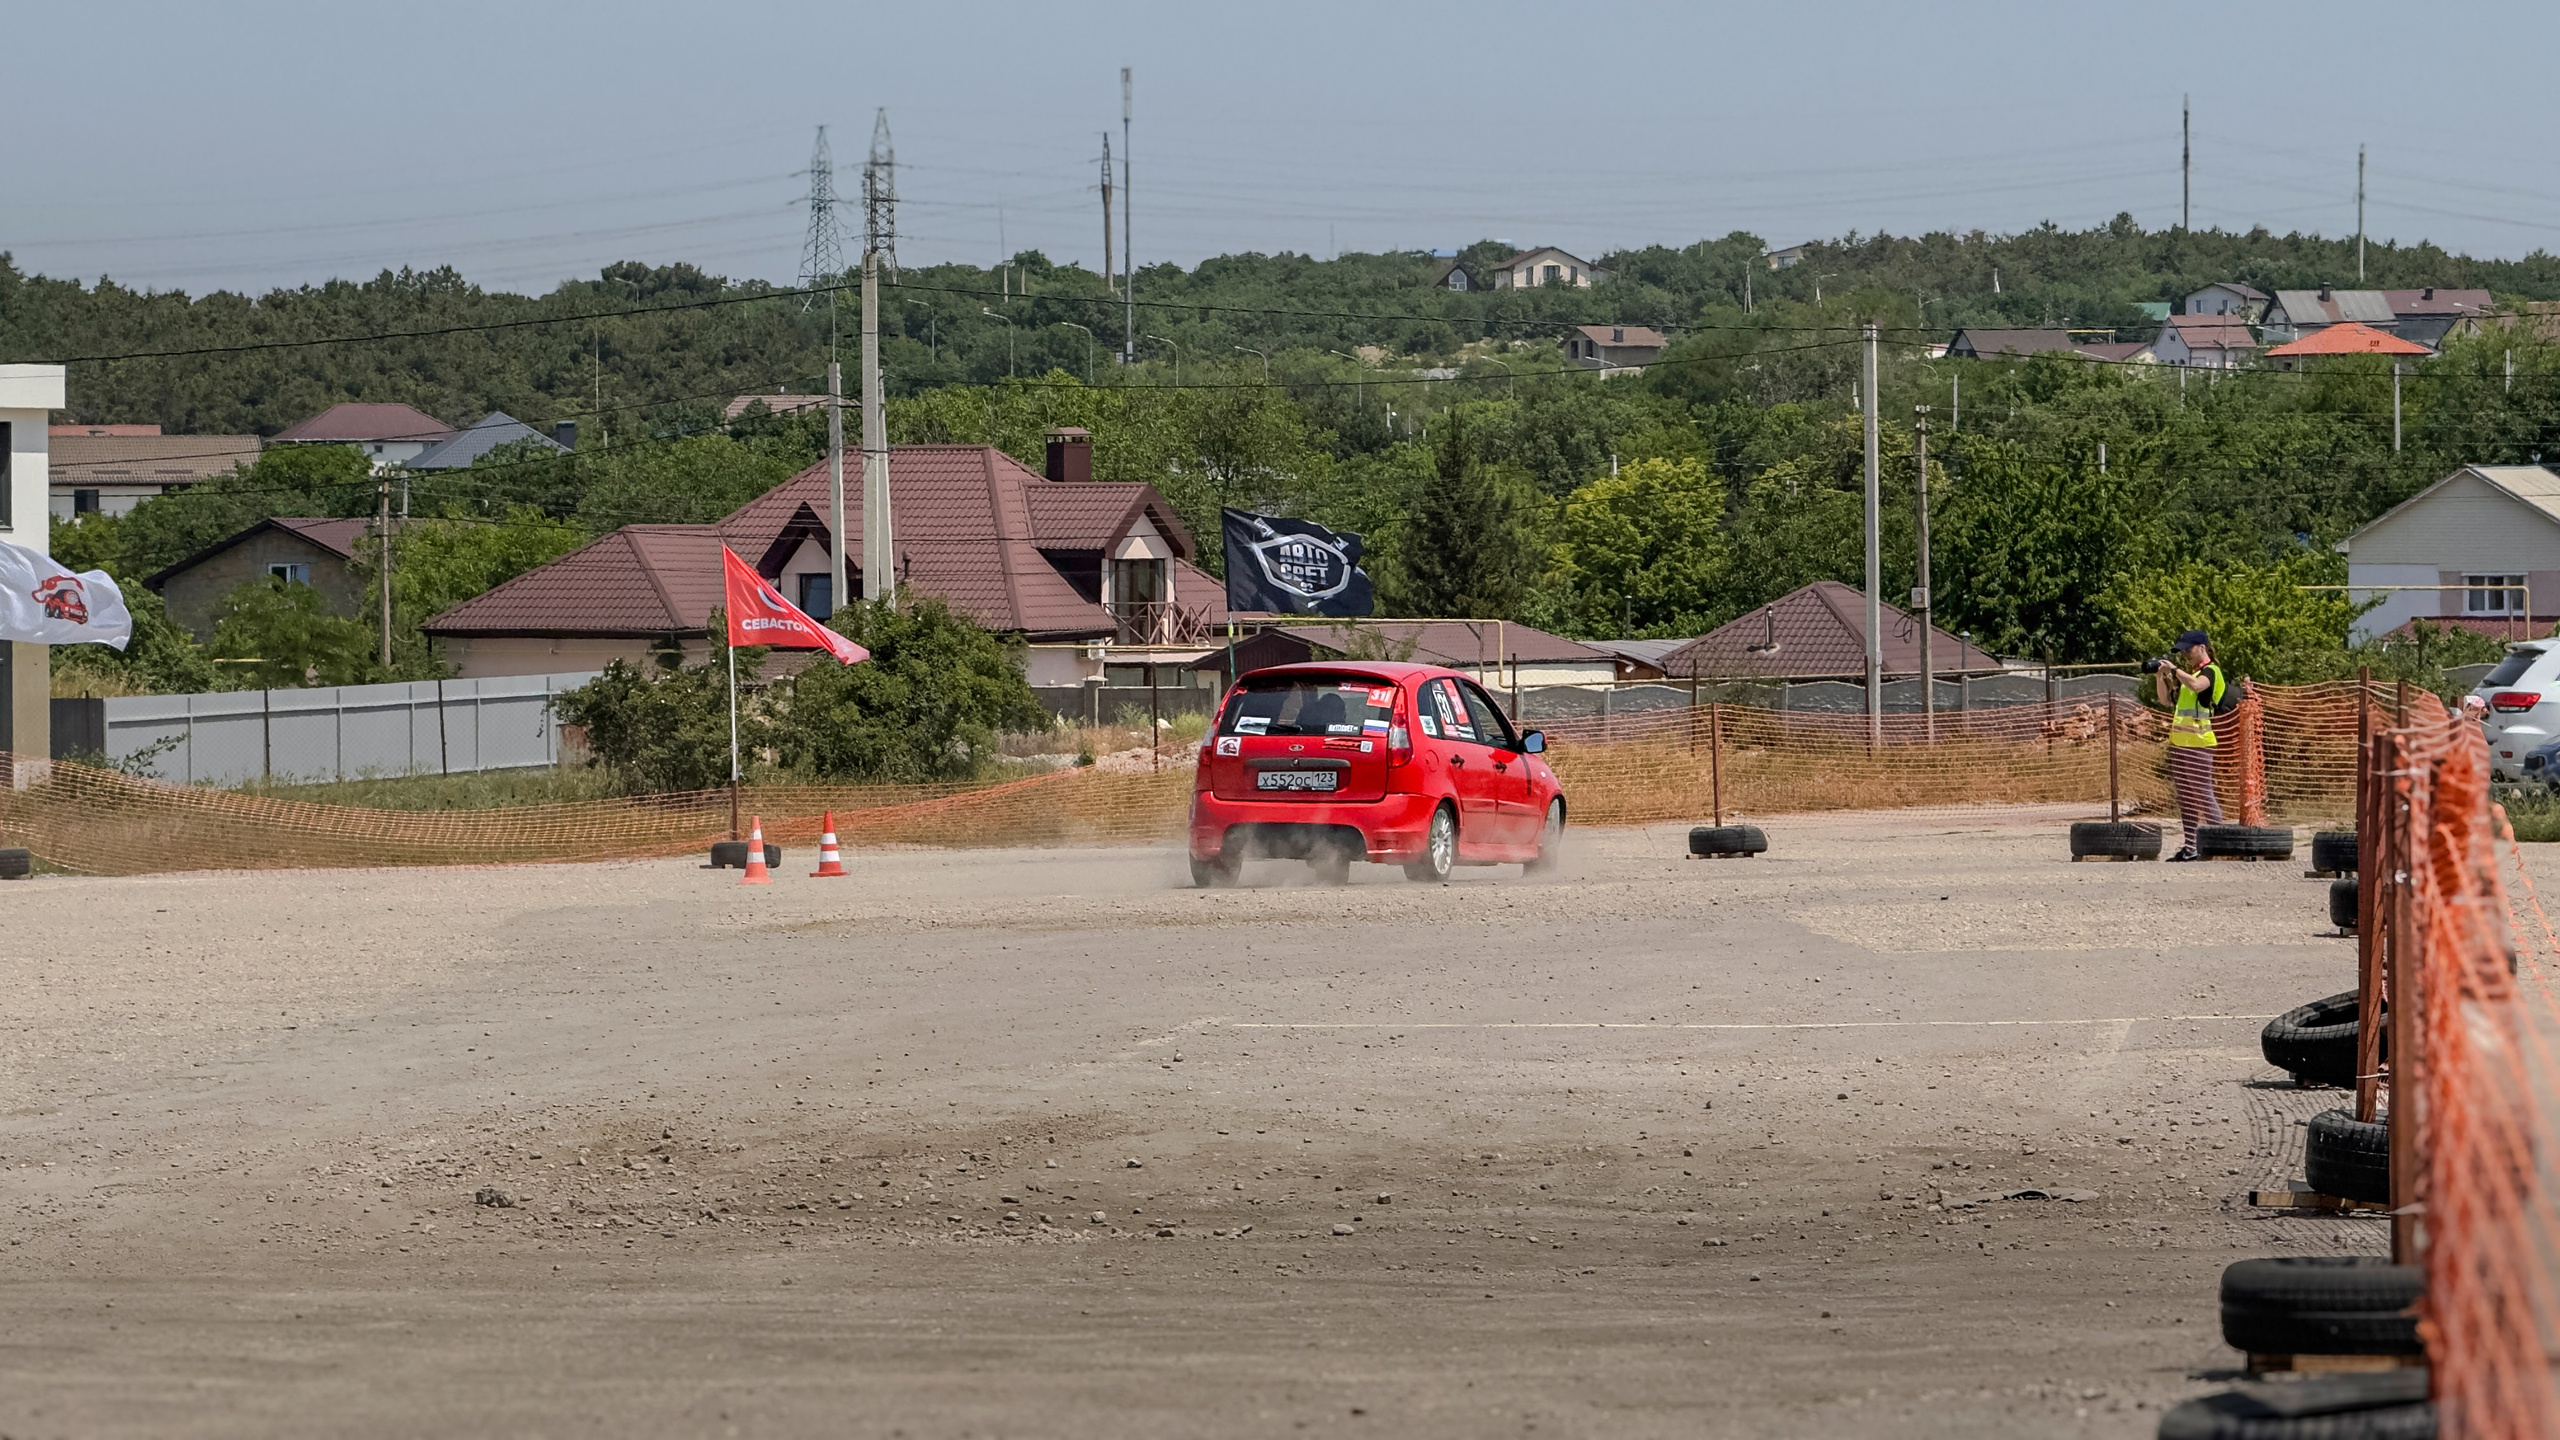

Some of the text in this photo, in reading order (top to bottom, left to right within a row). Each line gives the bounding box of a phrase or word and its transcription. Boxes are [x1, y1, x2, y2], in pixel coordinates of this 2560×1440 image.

[1280, 542, 1328, 567] АВТО
[1280, 563, 1328, 586] СВЕТ
[1315, 772, 1335, 783] 123
